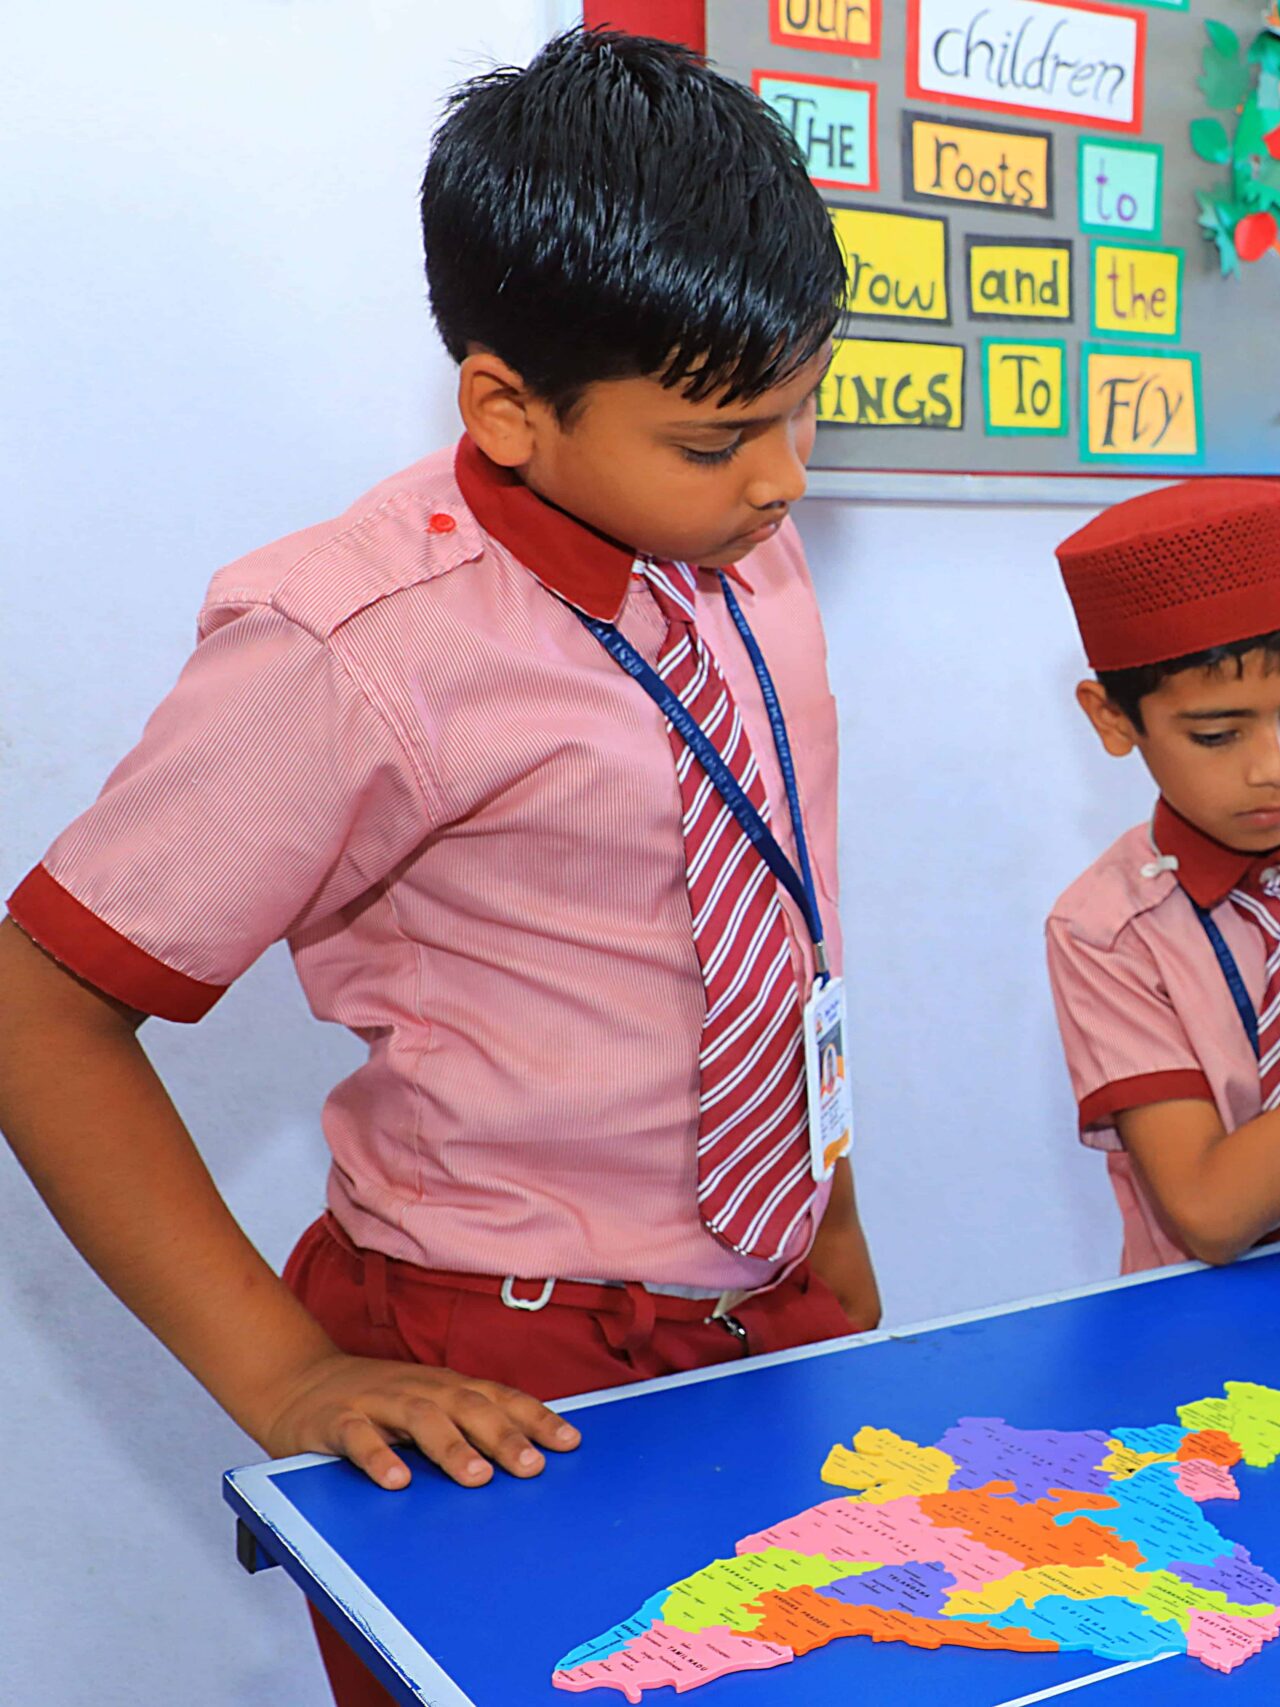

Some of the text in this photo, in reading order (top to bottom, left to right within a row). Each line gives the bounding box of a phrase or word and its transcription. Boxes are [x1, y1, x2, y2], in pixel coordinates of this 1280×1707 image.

[934, 9, 1126, 104] children
[931, 136, 1034, 207] roots
[1095, 158, 1138, 222] to
[848, 252, 1167, 320] row and the
[1000, 354, 1051, 416] To
[663, 695, 707, 755] SCHOOL
